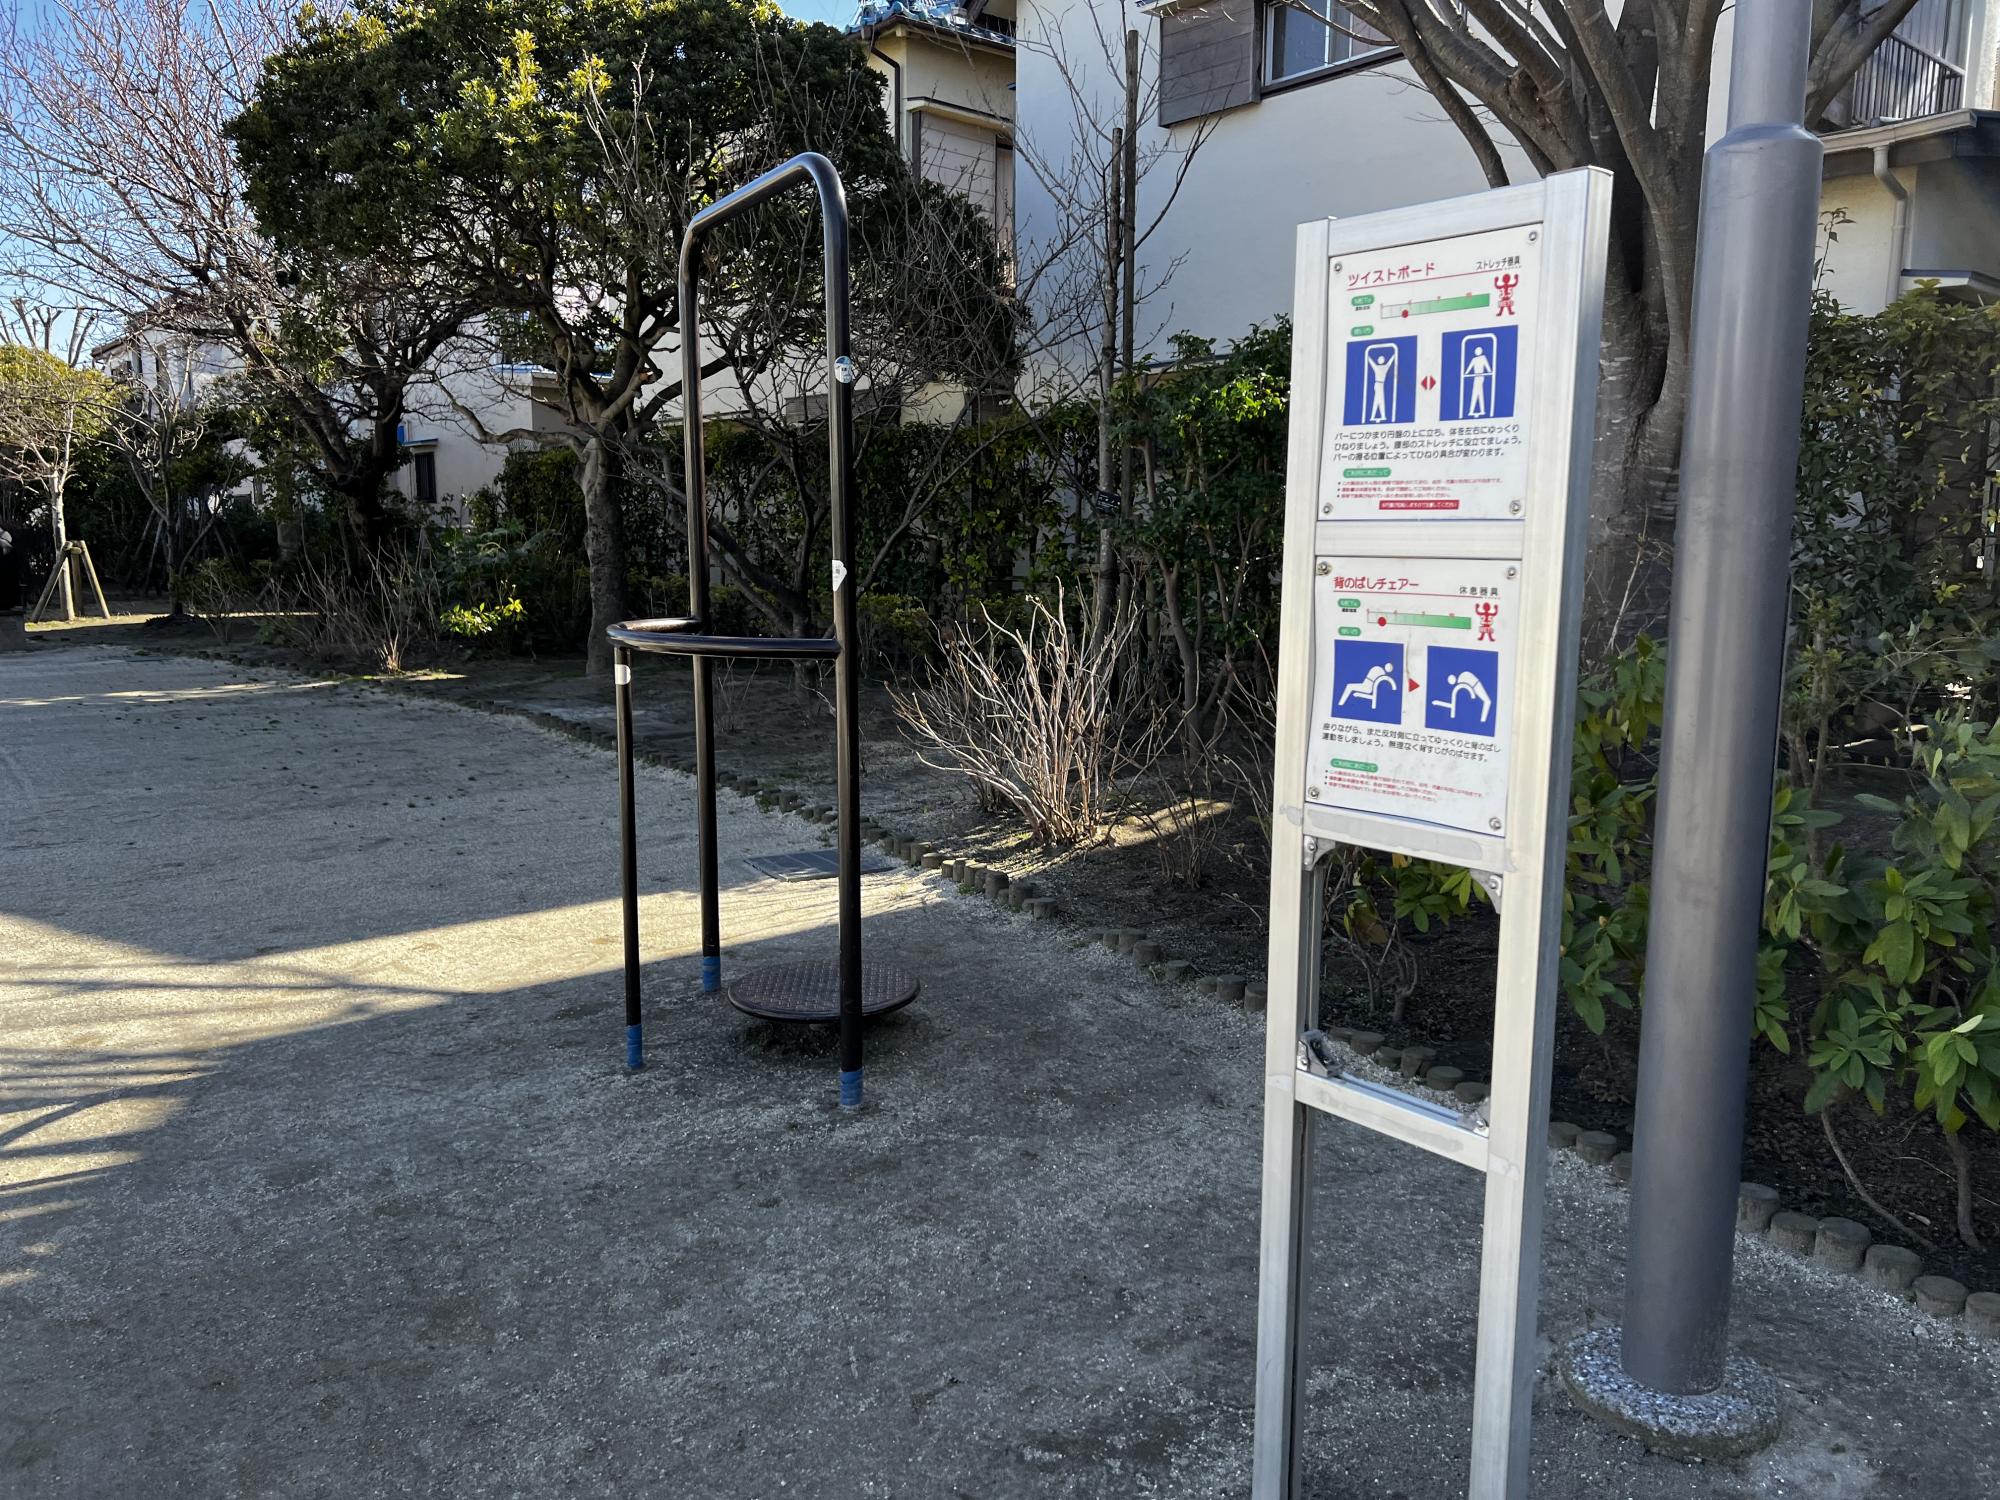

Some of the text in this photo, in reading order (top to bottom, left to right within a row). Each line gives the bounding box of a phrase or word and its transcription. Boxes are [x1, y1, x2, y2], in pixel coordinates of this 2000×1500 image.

[1348, 262, 1435, 286] ツイストボード
[1333, 576, 1419, 590] 背のばしチェアー
